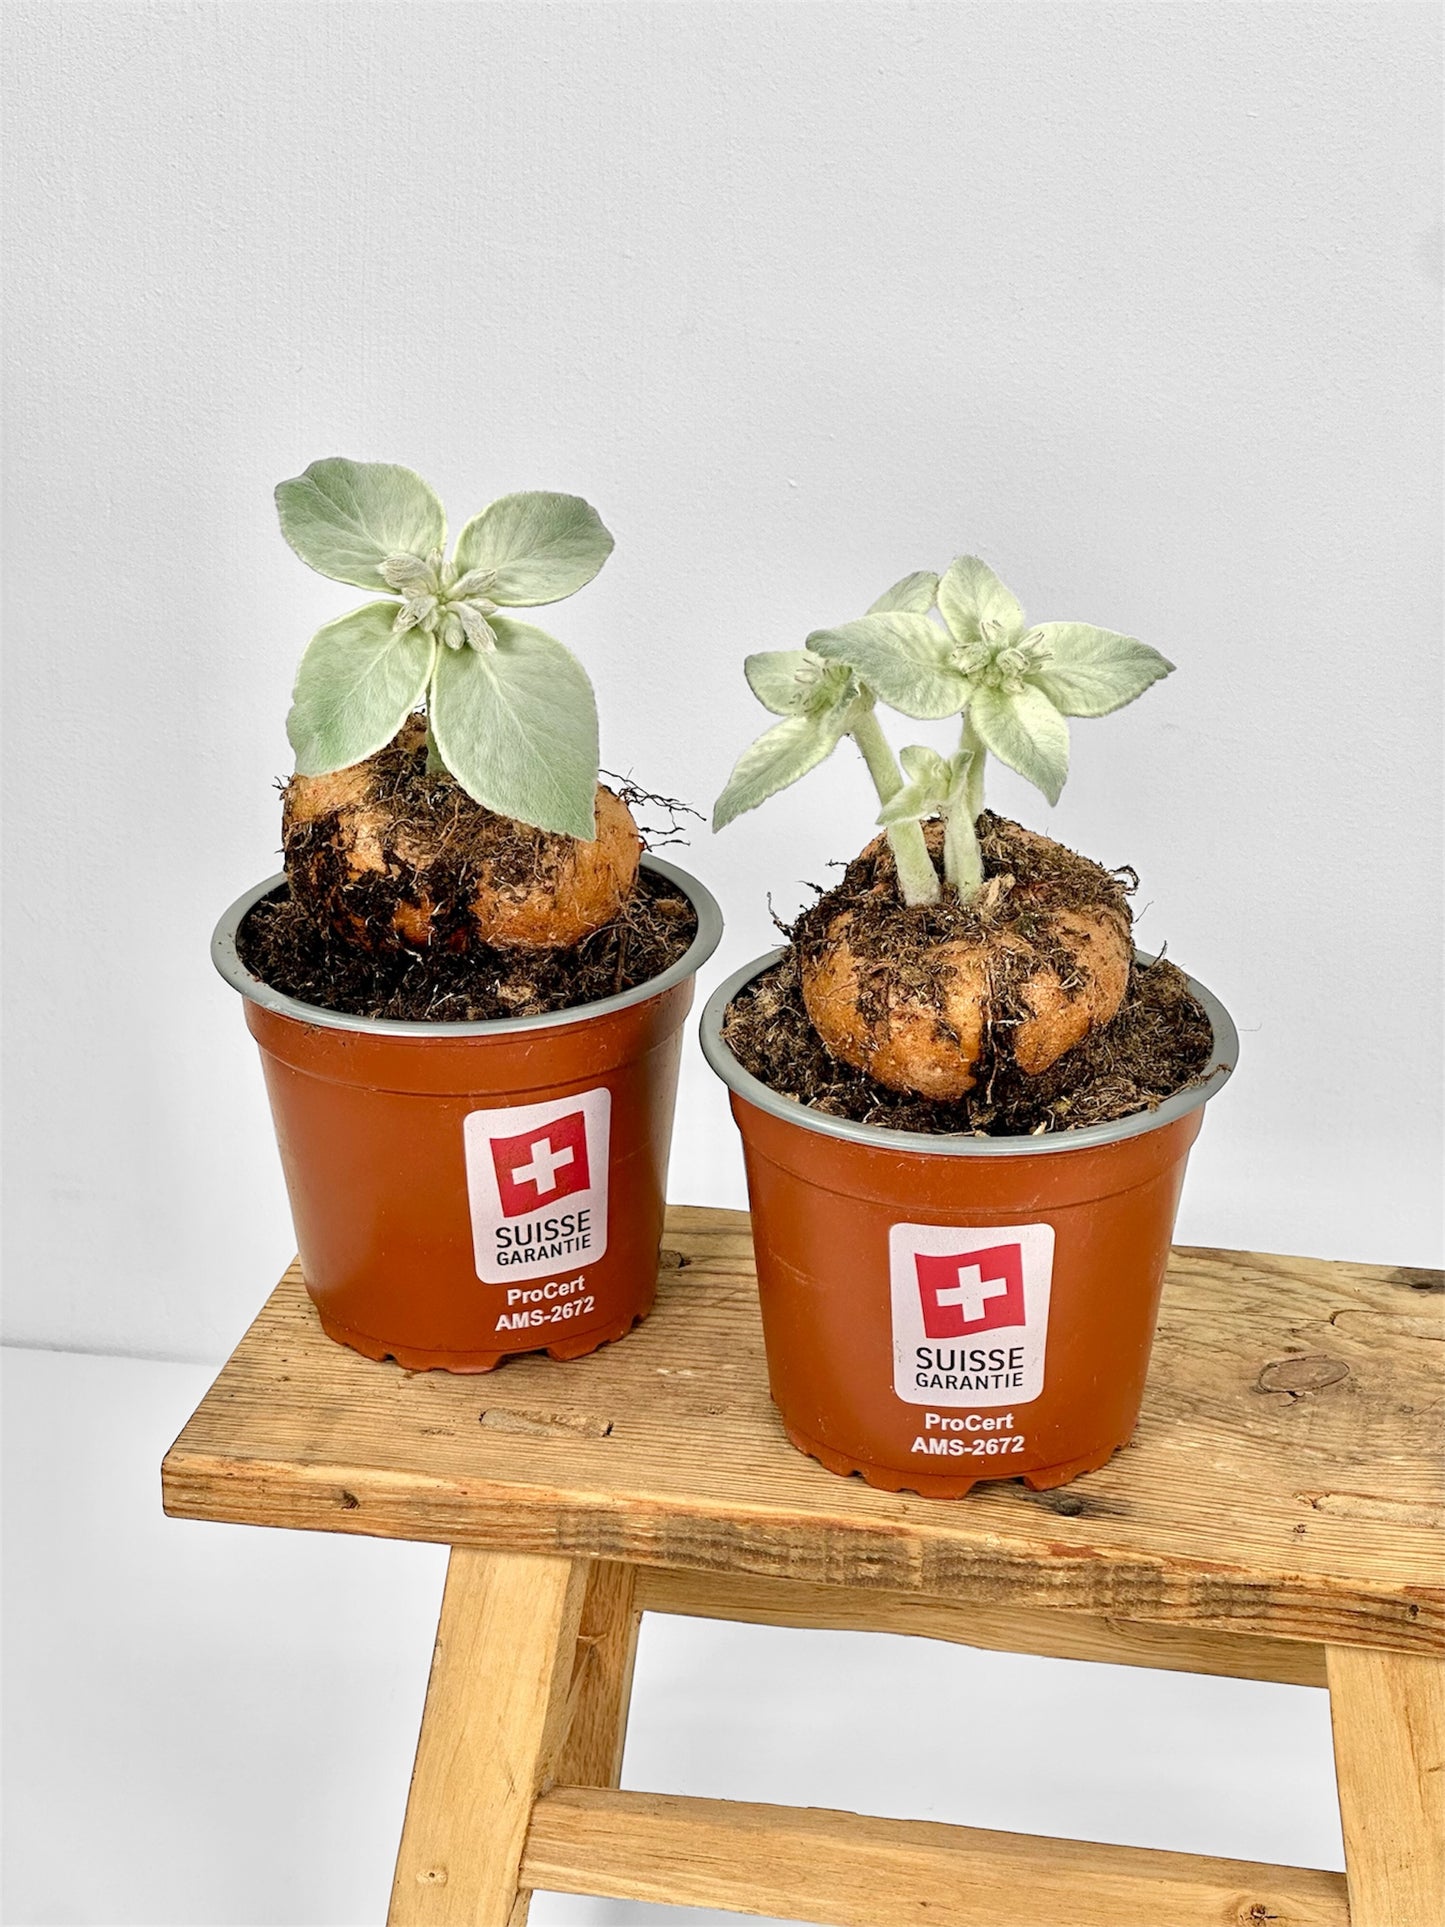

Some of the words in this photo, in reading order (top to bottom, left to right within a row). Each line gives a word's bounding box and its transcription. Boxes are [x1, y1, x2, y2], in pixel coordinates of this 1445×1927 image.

[495, 1208, 592, 1249] SUISSE
[496, 1233, 592, 1266] GARANTIE
[507, 1274, 586, 1306] ProCert
[494, 1295, 595, 1332] AMS-2672
[916, 1346, 1025, 1372] SUISSE
[915, 1372, 1024, 1390] GARANTIE
[925, 1412, 1014, 1431] ProCert
[911, 1435, 1025, 1456] AMS-2672
